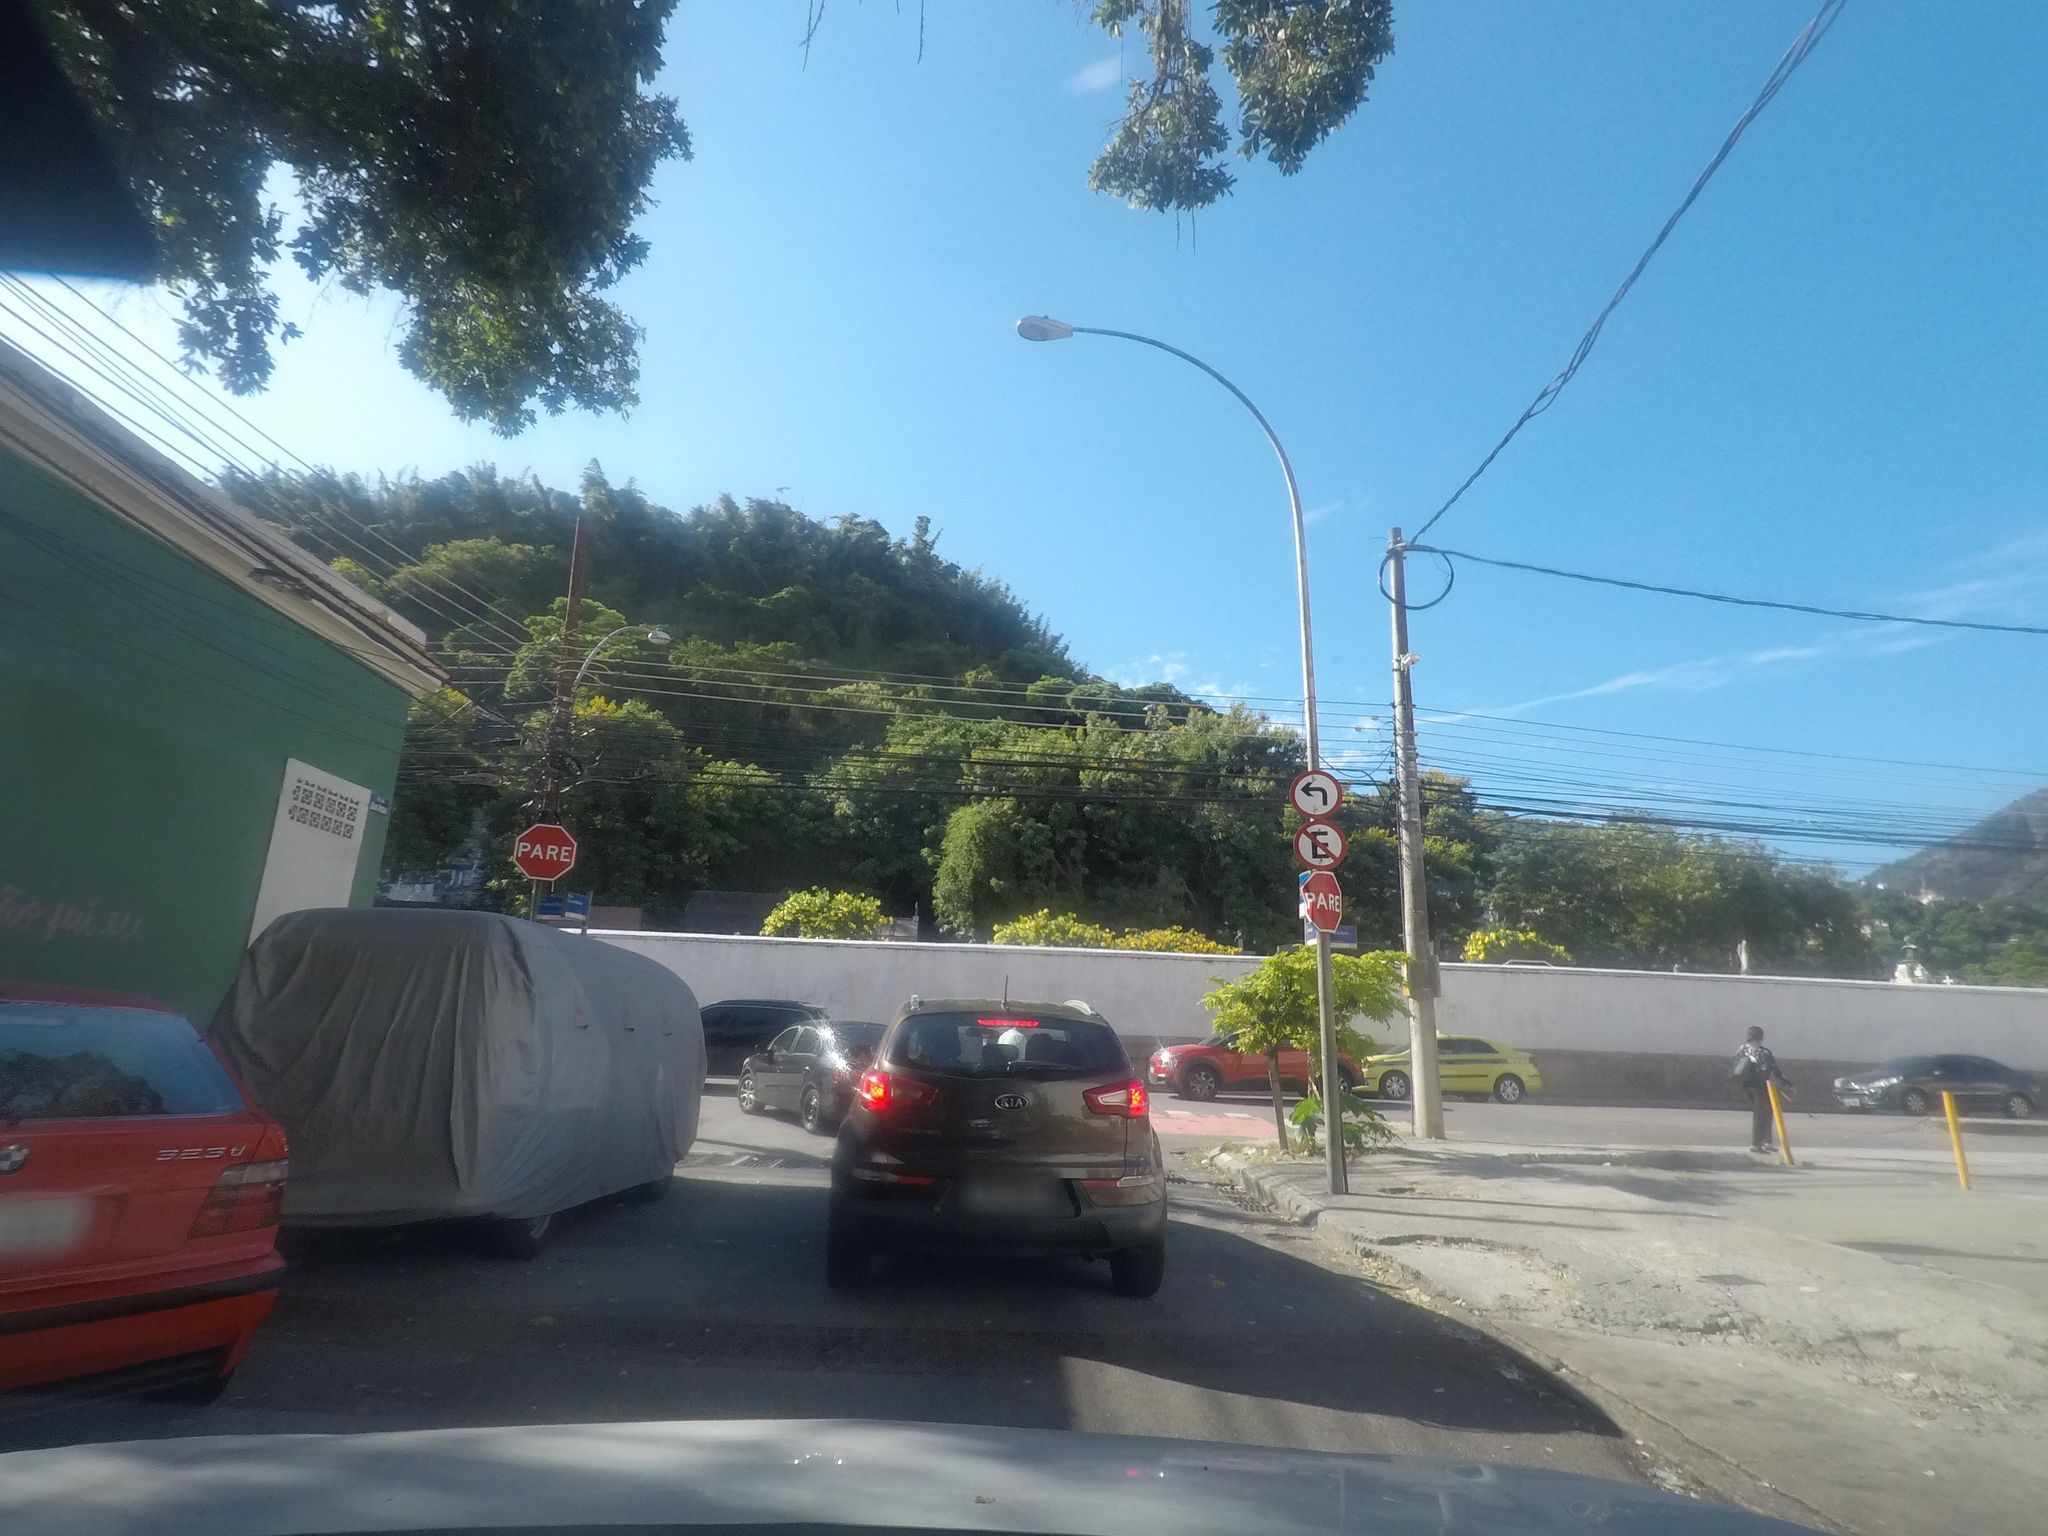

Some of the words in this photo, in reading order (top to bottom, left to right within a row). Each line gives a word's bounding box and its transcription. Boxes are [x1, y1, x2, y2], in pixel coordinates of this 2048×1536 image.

[518, 842, 572, 862] PARE
[1305, 892, 1340, 912] PARE
[999, 1095, 1025, 1109] KIA
